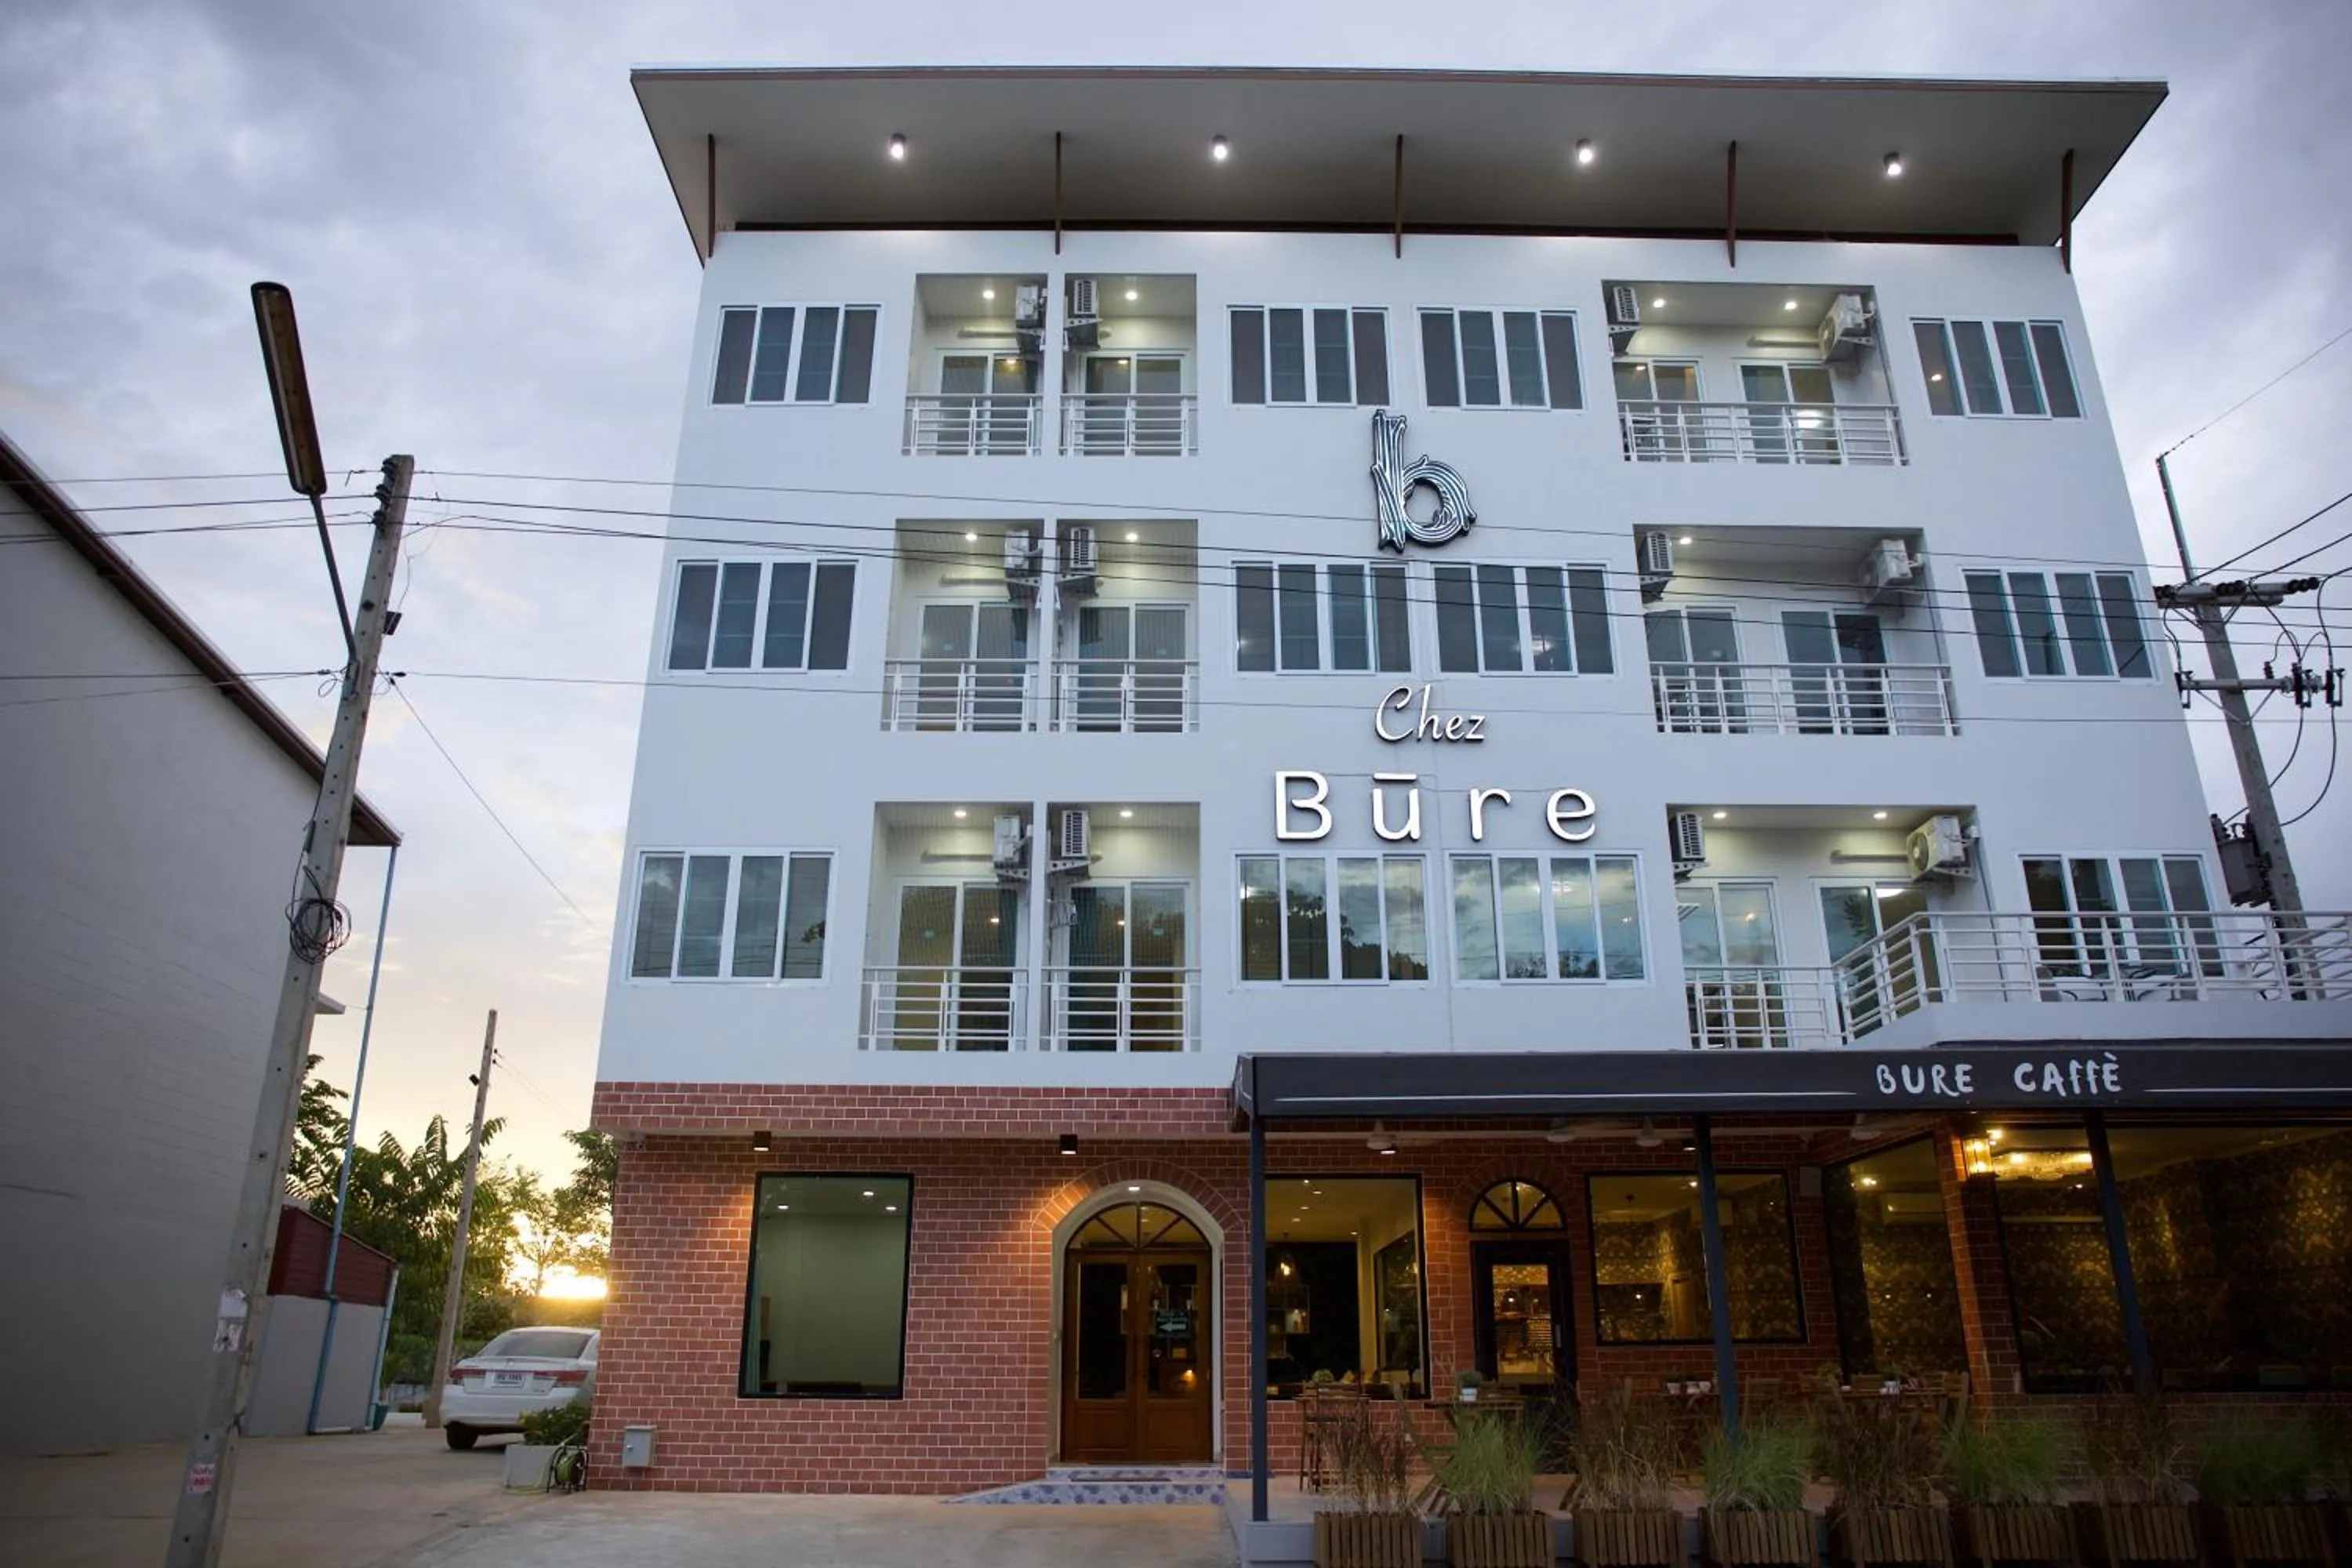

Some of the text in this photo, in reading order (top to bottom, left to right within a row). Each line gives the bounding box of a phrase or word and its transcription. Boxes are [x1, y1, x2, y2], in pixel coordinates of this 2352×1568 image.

[1374, 684, 1487, 742] Chez
[1275, 770, 1597, 843] Būre
[1875, 1051, 2122, 1098] BURE CAFFÈ
